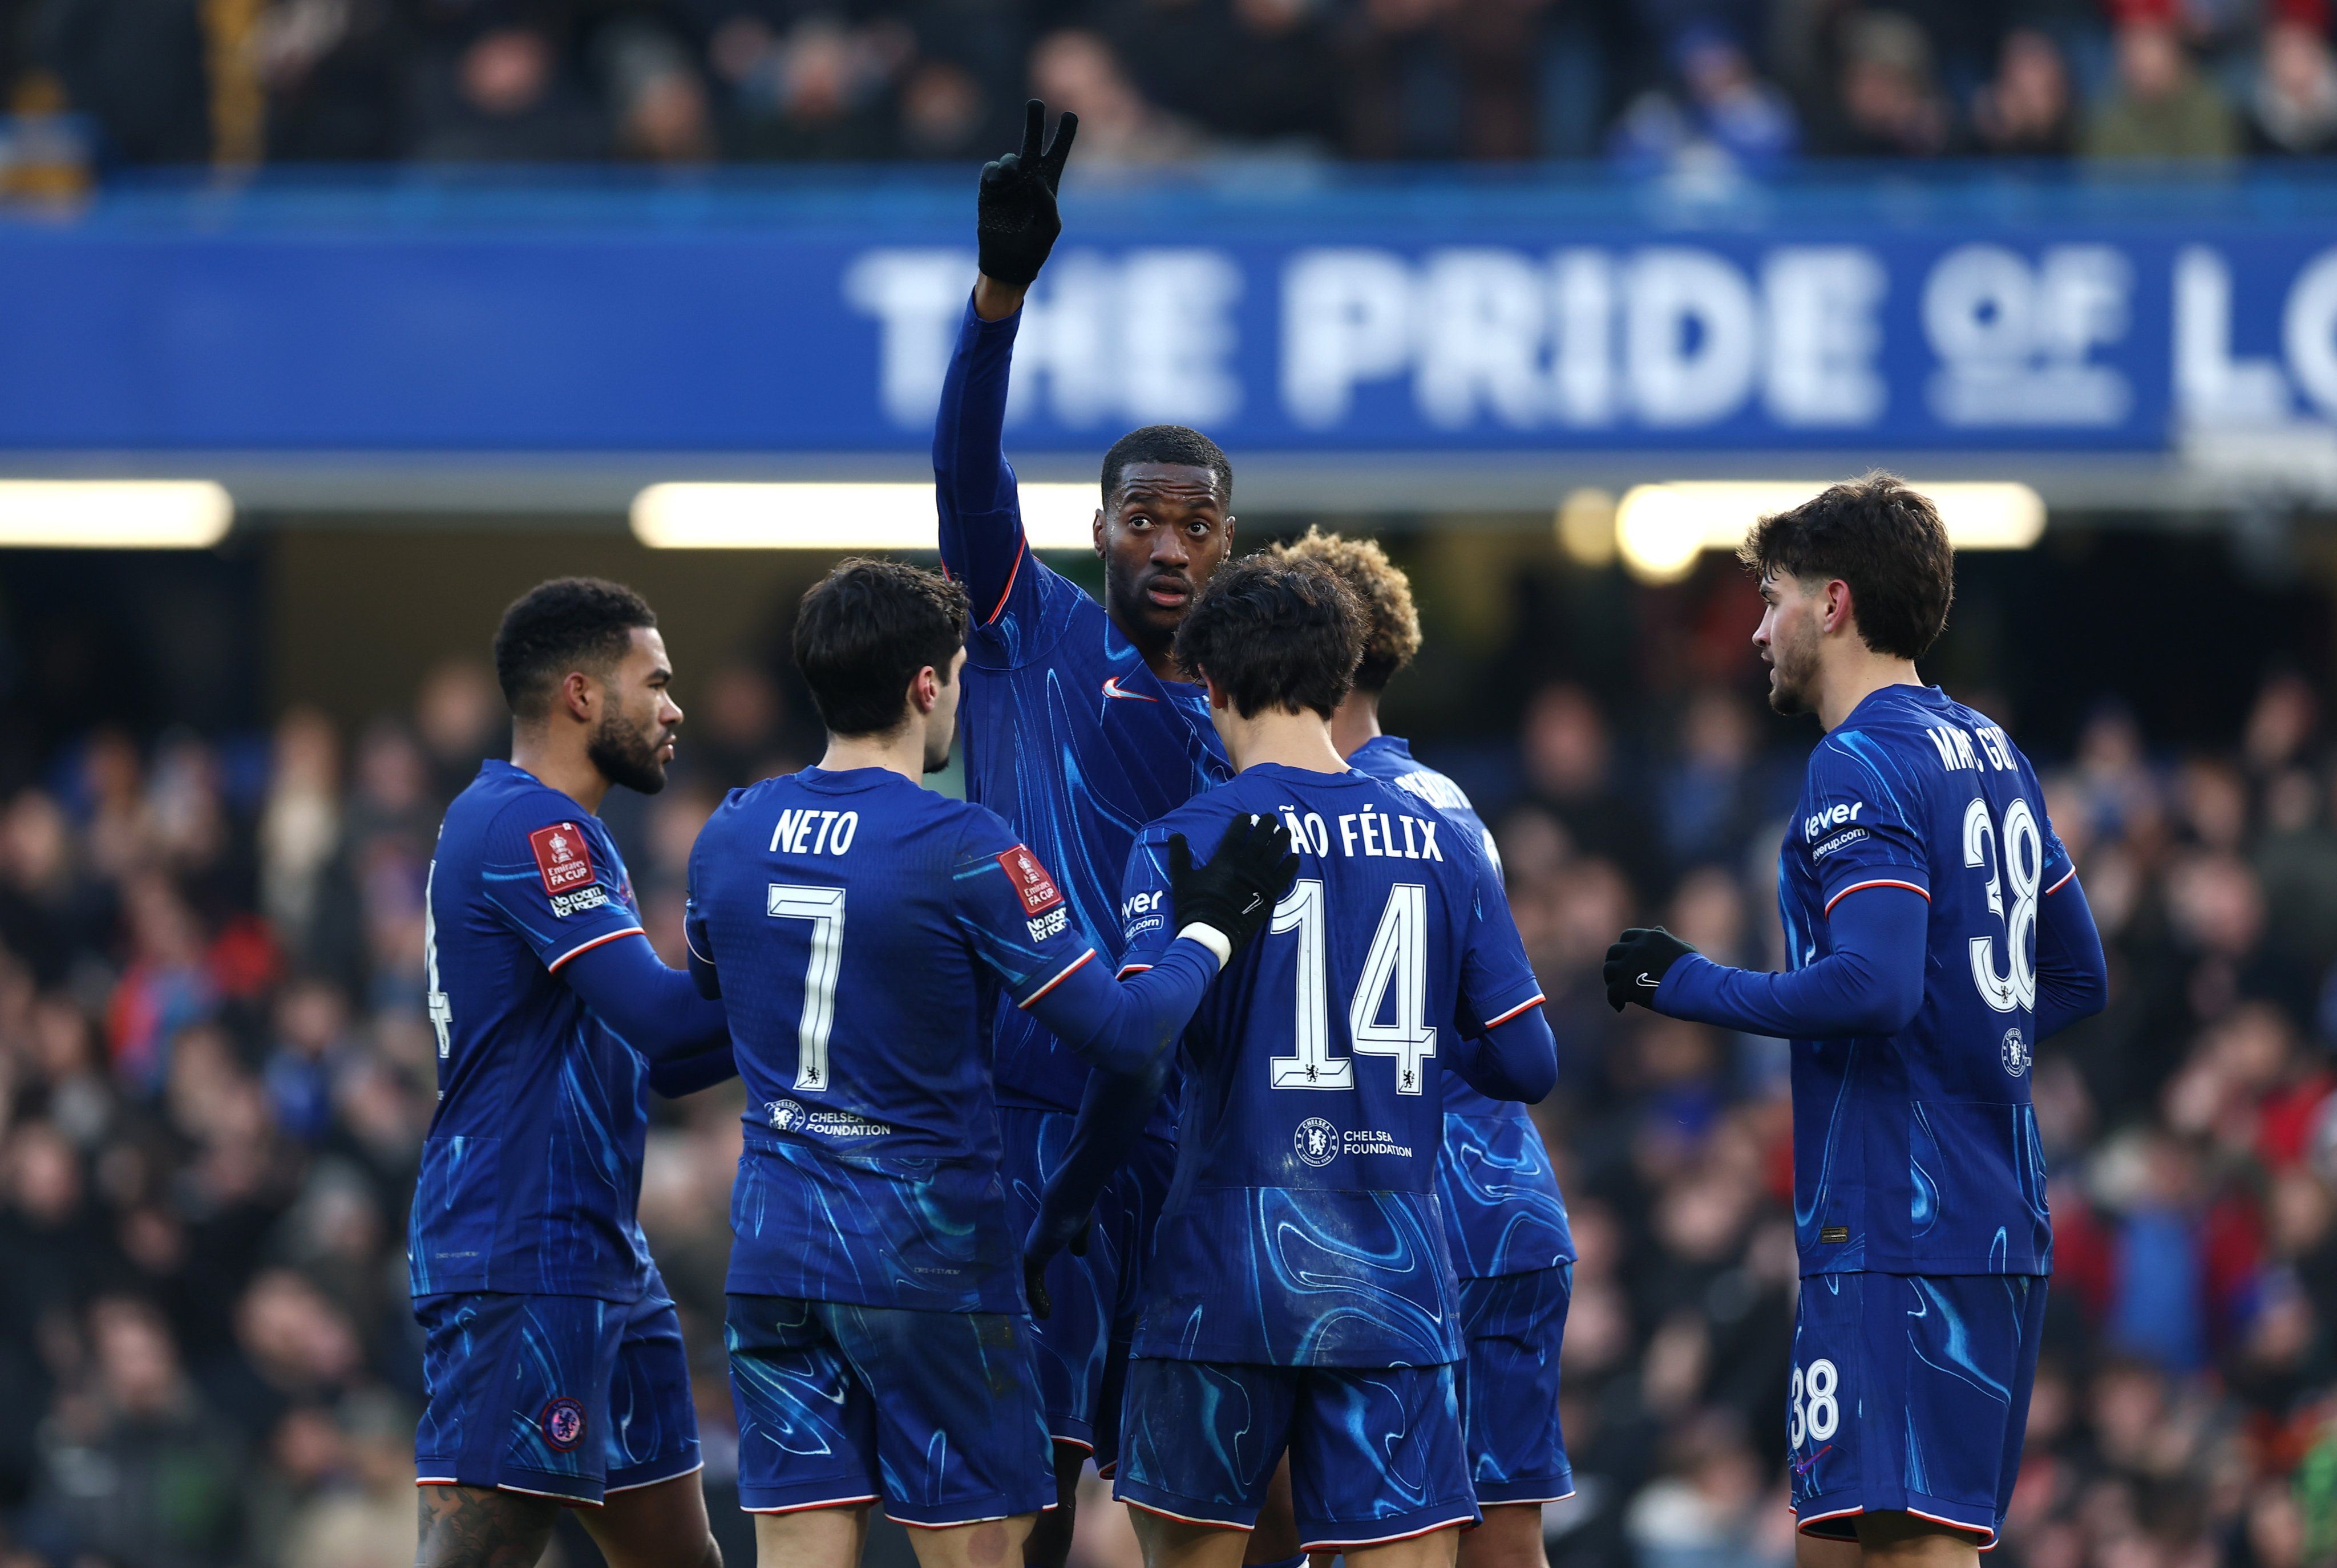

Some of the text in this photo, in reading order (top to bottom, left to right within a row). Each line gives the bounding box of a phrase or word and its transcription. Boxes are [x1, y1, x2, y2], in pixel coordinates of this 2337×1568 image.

[849, 248, 1241, 425] THE
[1281, 248, 1887, 428] PRIDE
[1924, 245, 2131, 371] OF
[769, 809, 858, 856] NETO
[1250, 804, 1444, 862] ÃO FÉLIX
[548, 860, 585, 876] Emirates
[551, 868, 587, 886] FA CUP
[549, 886, 601, 908] No room
[553, 894, 610, 918] for racism
[1028, 888, 1054, 906] FA CUP
[1122, 890, 1163, 919] ver
[1963, 797, 2042, 1014] 38
[1026, 918, 1046, 932] No
[1031, 928, 1048, 943] for
[767, 883, 847, 1092] 7
[1270, 878, 1437, 1096] 14
[809, 1112, 864, 1123] CHELSEA
[1303, 1119, 1330, 1131] CHELSEA
[805, 1124, 891, 1136] FOUNDATION
[1344, 1131, 1393, 1143] CHELSEA
[1344, 1144, 1413, 1157] FOUNDATION
[1791, 1359, 1839, 1449] 38
